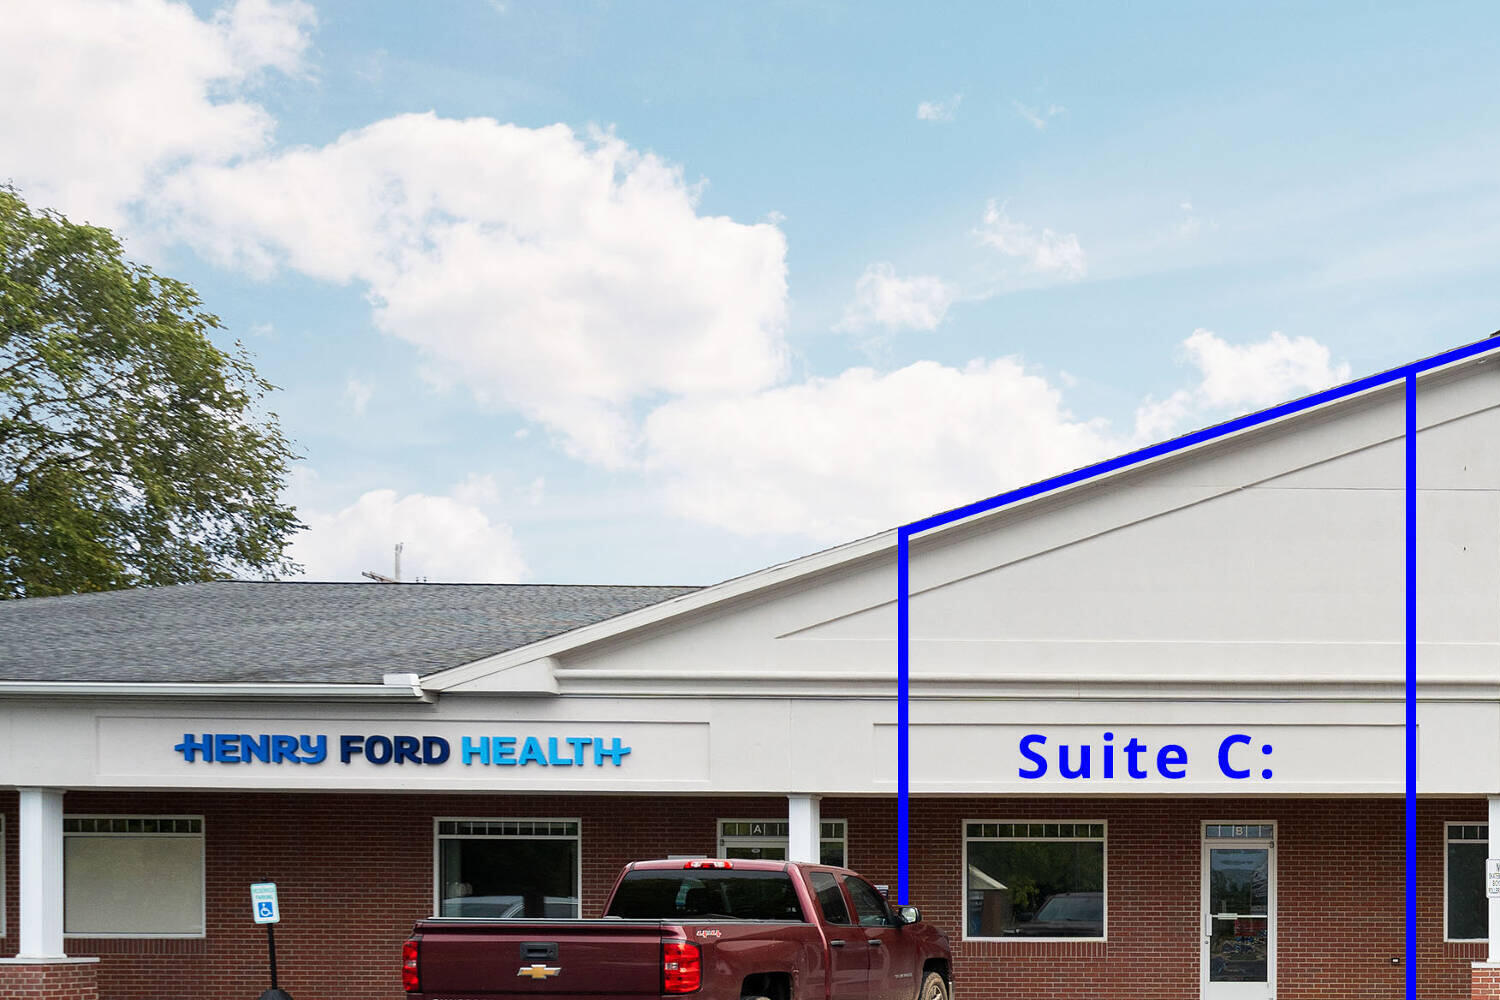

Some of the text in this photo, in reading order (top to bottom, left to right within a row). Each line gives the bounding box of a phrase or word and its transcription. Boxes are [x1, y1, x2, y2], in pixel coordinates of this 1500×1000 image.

[174, 733, 632, 767] HENRY FORD HEALTH
[753, 824, 762, 834] A
